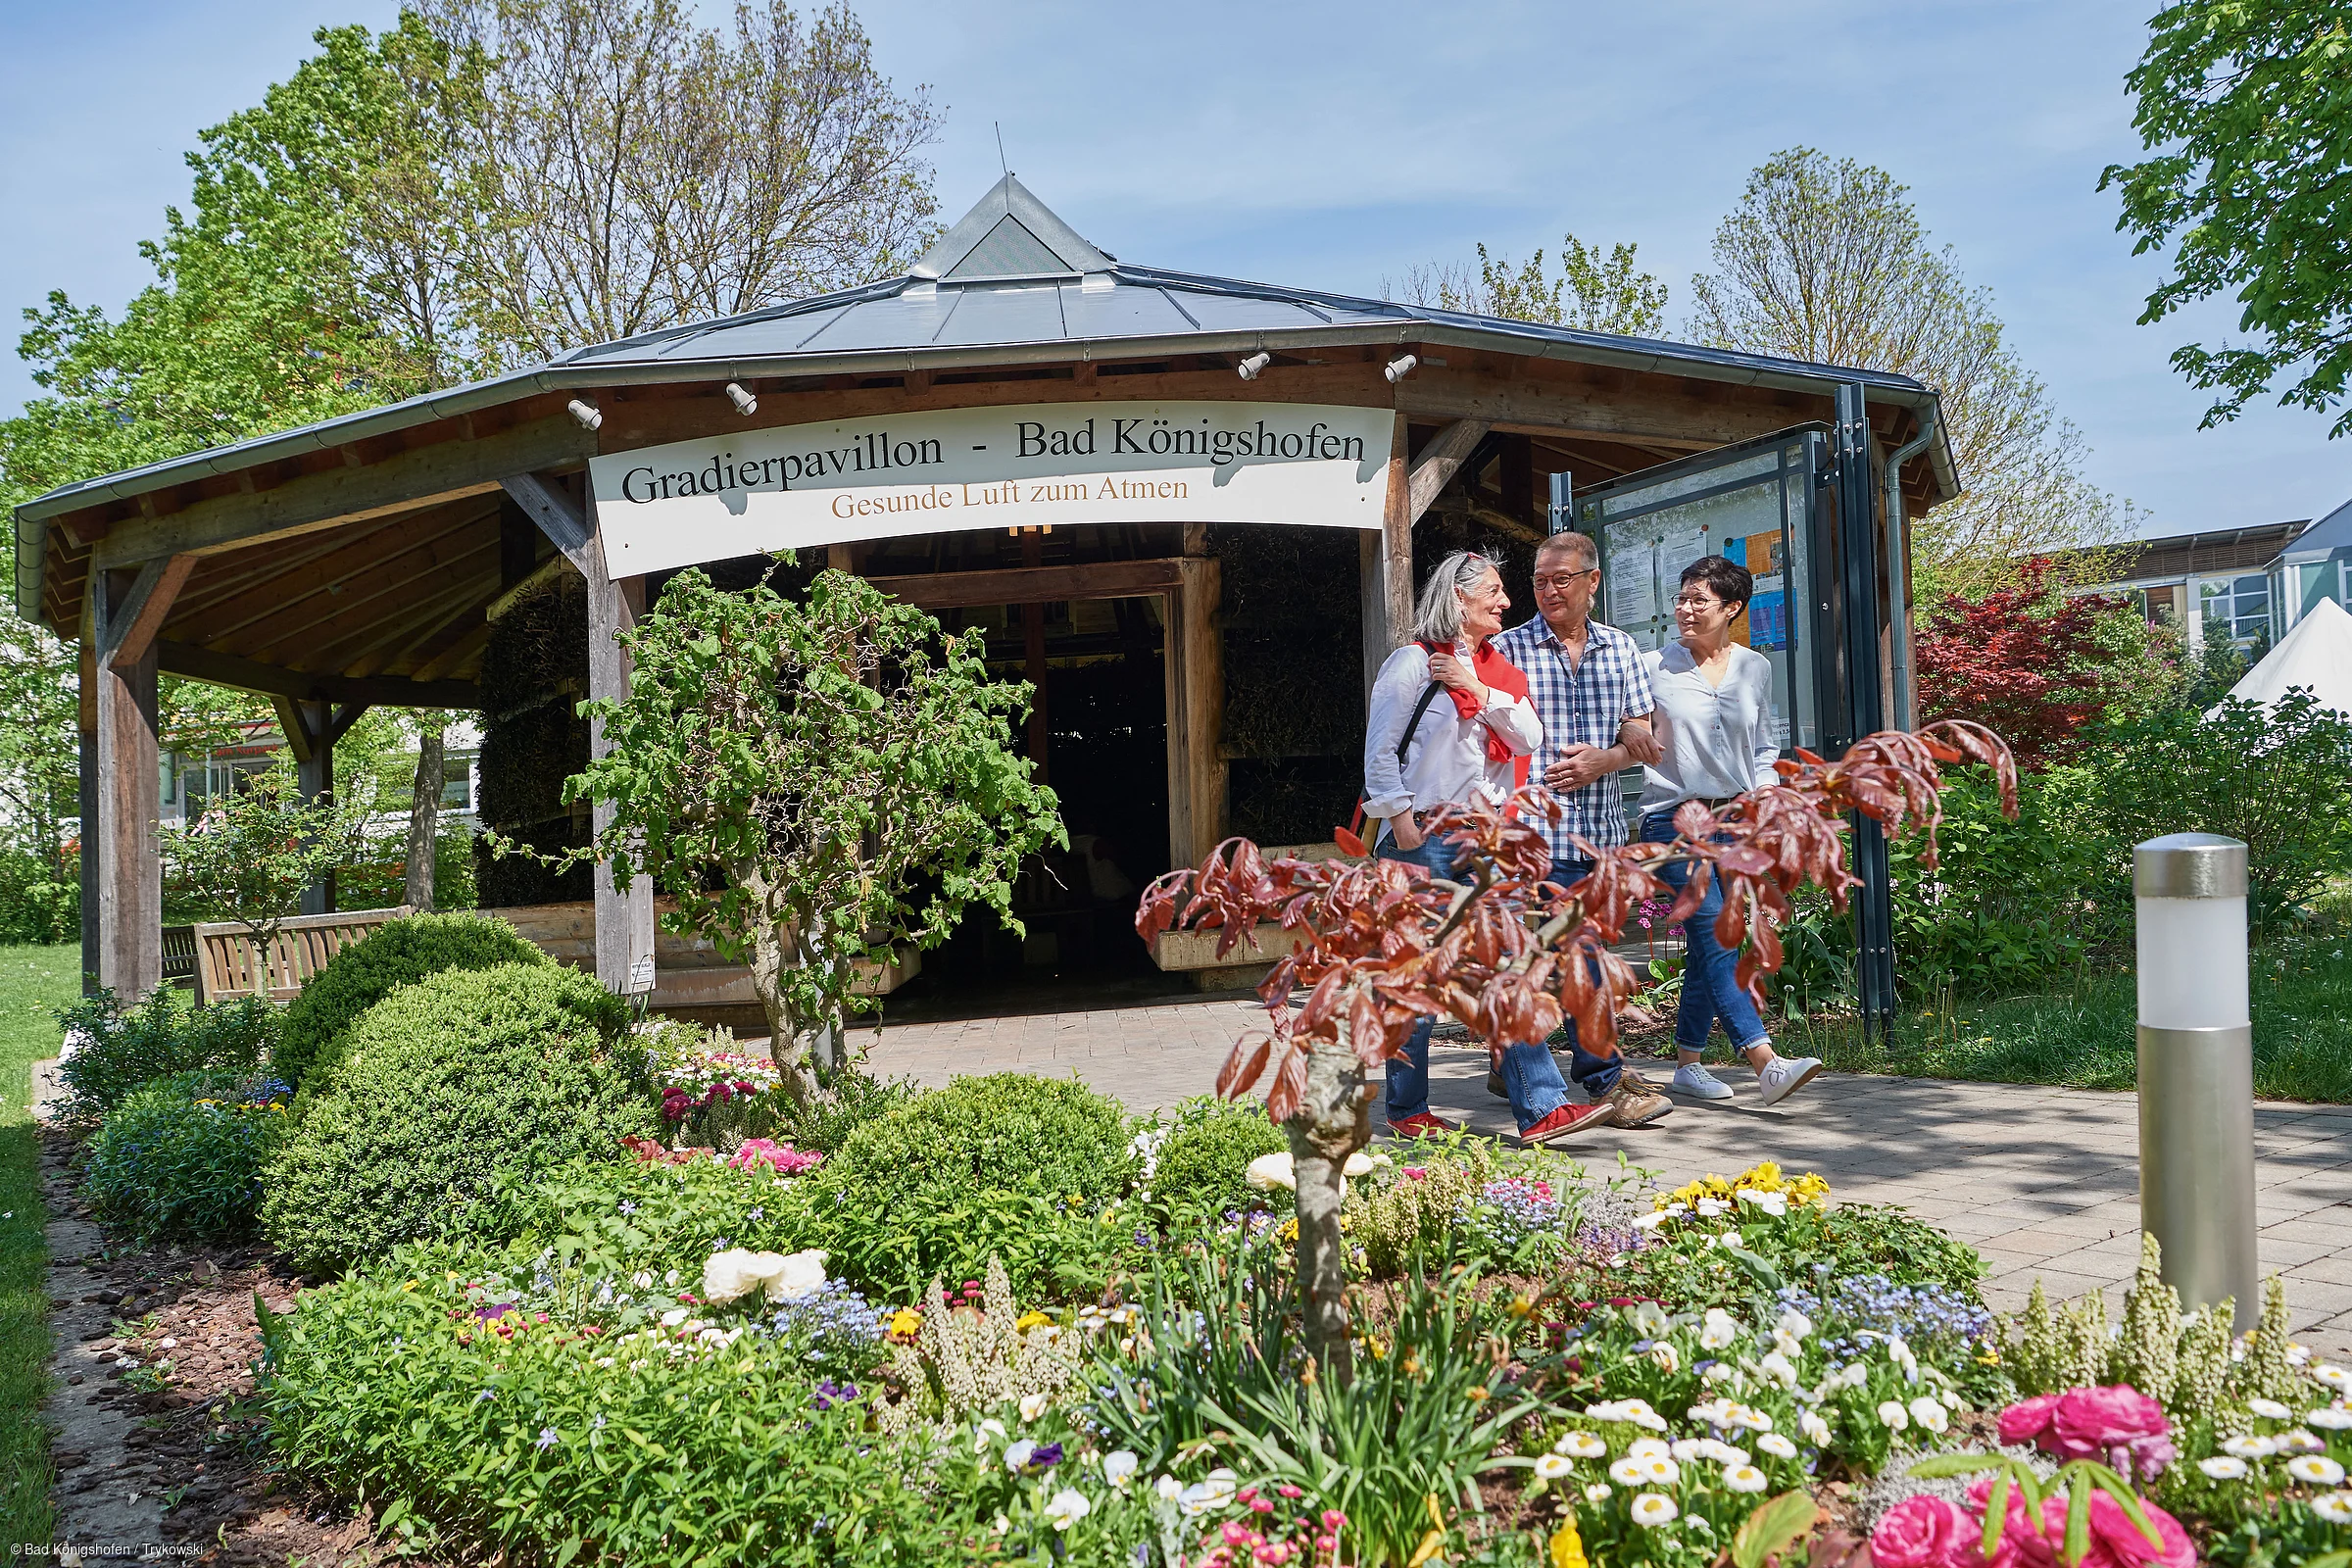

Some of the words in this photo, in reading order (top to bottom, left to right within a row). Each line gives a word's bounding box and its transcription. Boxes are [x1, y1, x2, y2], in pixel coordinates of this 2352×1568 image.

[621, 431, 945, 505] Gradierpavillon
[1014, 417, 1098, 459] Bad
[1110, 417, 1366, 466] Königshofen
[831, 485, 954, 519] Gesunde
[961, 479, 1021, 510] Luft
[1030, 480, 1089, 505] zum
[1096, 475, 1189, 502] Atmen
